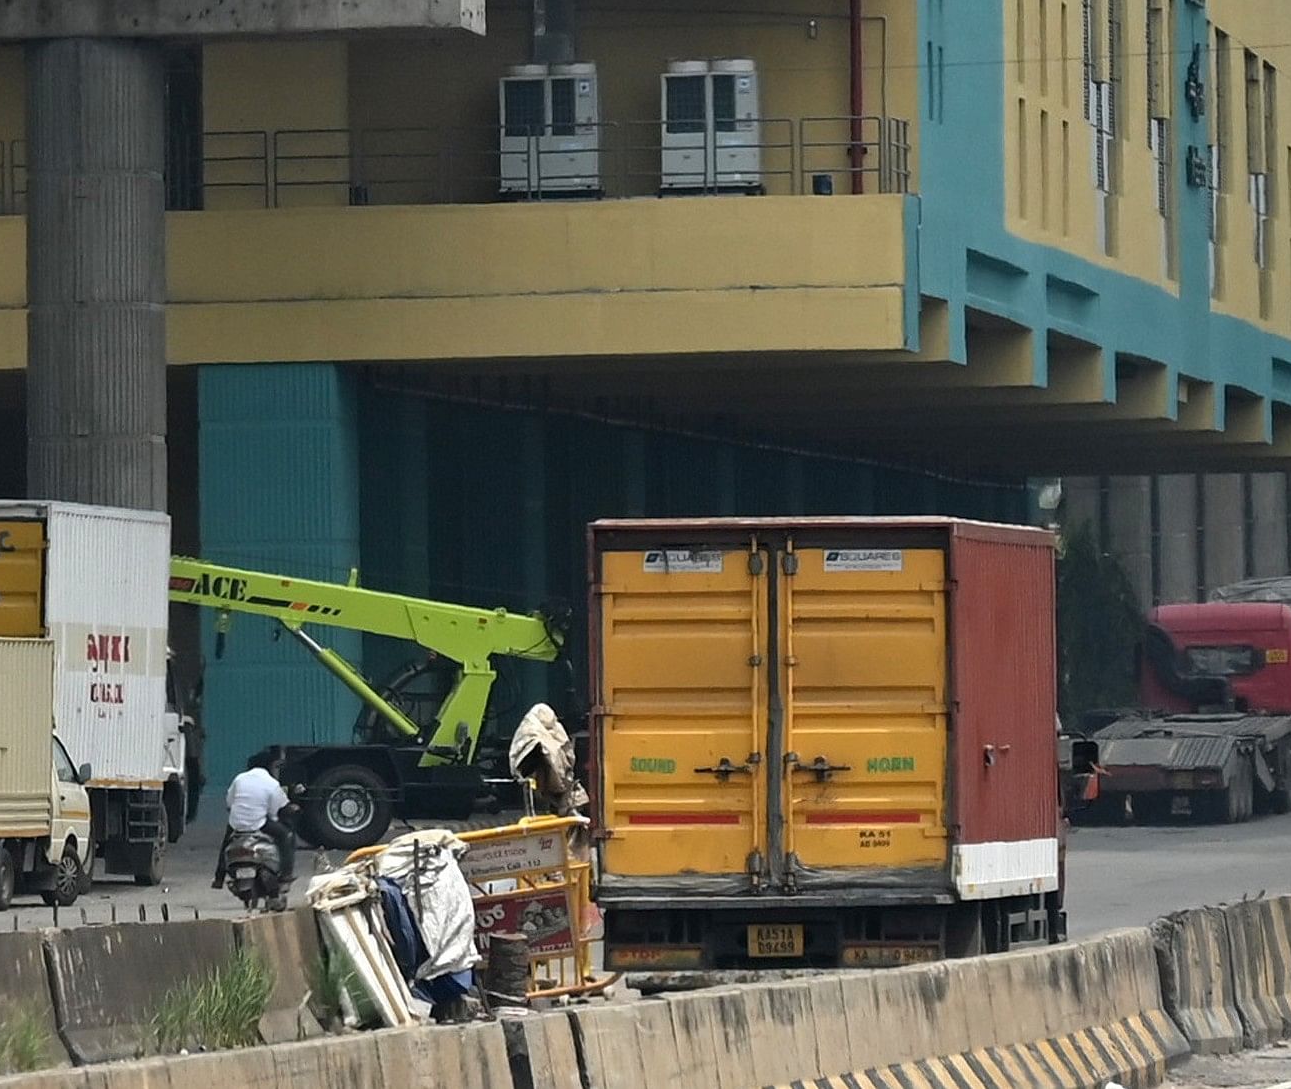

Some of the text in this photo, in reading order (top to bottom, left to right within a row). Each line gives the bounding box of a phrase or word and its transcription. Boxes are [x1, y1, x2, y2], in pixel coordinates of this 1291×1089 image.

[840, 551, 901, 561] SQUARES
[193, 573, 249, 602] ACE
[630, 757, 676, 774] SOUND
